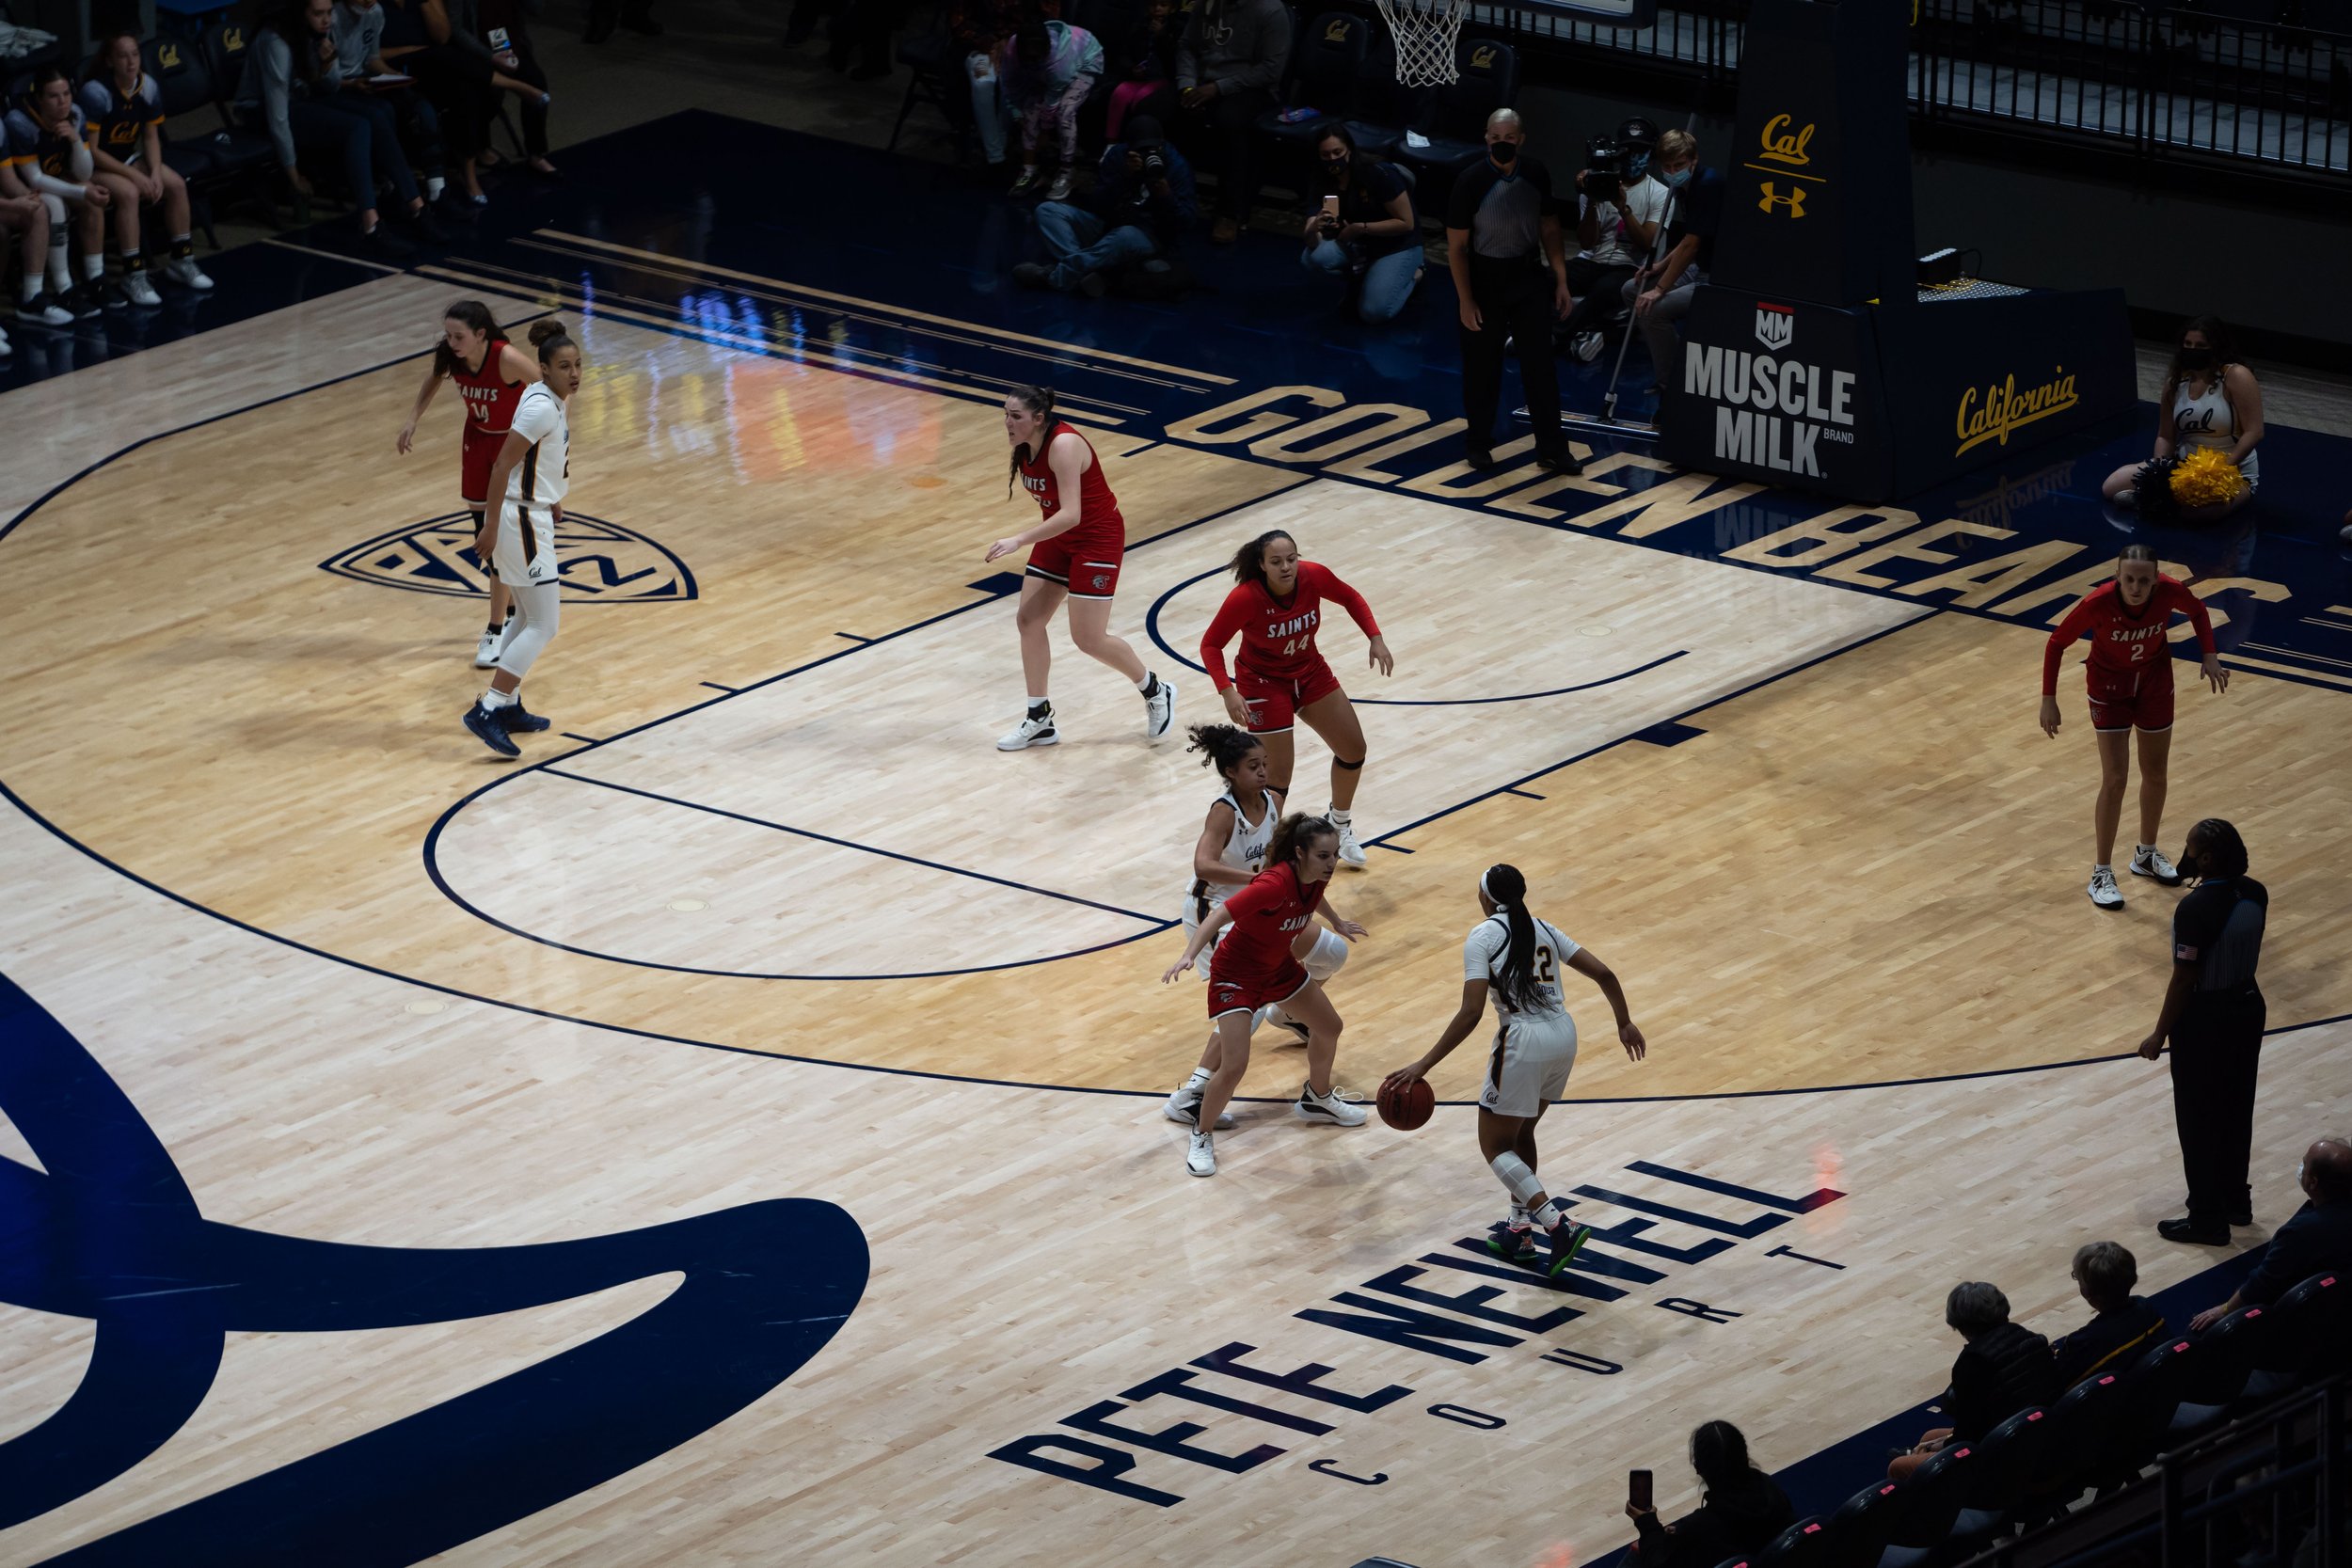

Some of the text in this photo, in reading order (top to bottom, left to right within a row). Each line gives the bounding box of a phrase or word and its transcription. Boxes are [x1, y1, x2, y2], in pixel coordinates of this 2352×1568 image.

[107, 121, 140, 145] Cal
[1759, 113, 1815, 166] Cal
[1756, 309, 1793, 351] MM
[1684, 341, 1856, 426] MUSCLE
[1955, 365, 2080, 459] California
[2175, 407, 2216, 435] Cal
[1714, 405, 1854, 478] MILK BRAND
[1164, 385, 1770, 539] GOLDEN
[528, 566, 543, 579] Cal
[1267, 610, 1317, 639] SAINTS
[2110, 622, 2164, 642] SAINTS
[1283, 634, 1310, 657] 44
[2131, 643, 2145, 662] 2
[1486, 1091, 1499, 1105] Cal
[984, 1160, 1848, 1508] PETE NEWELL
[1309, 1244, 1847, 1486] COURT
